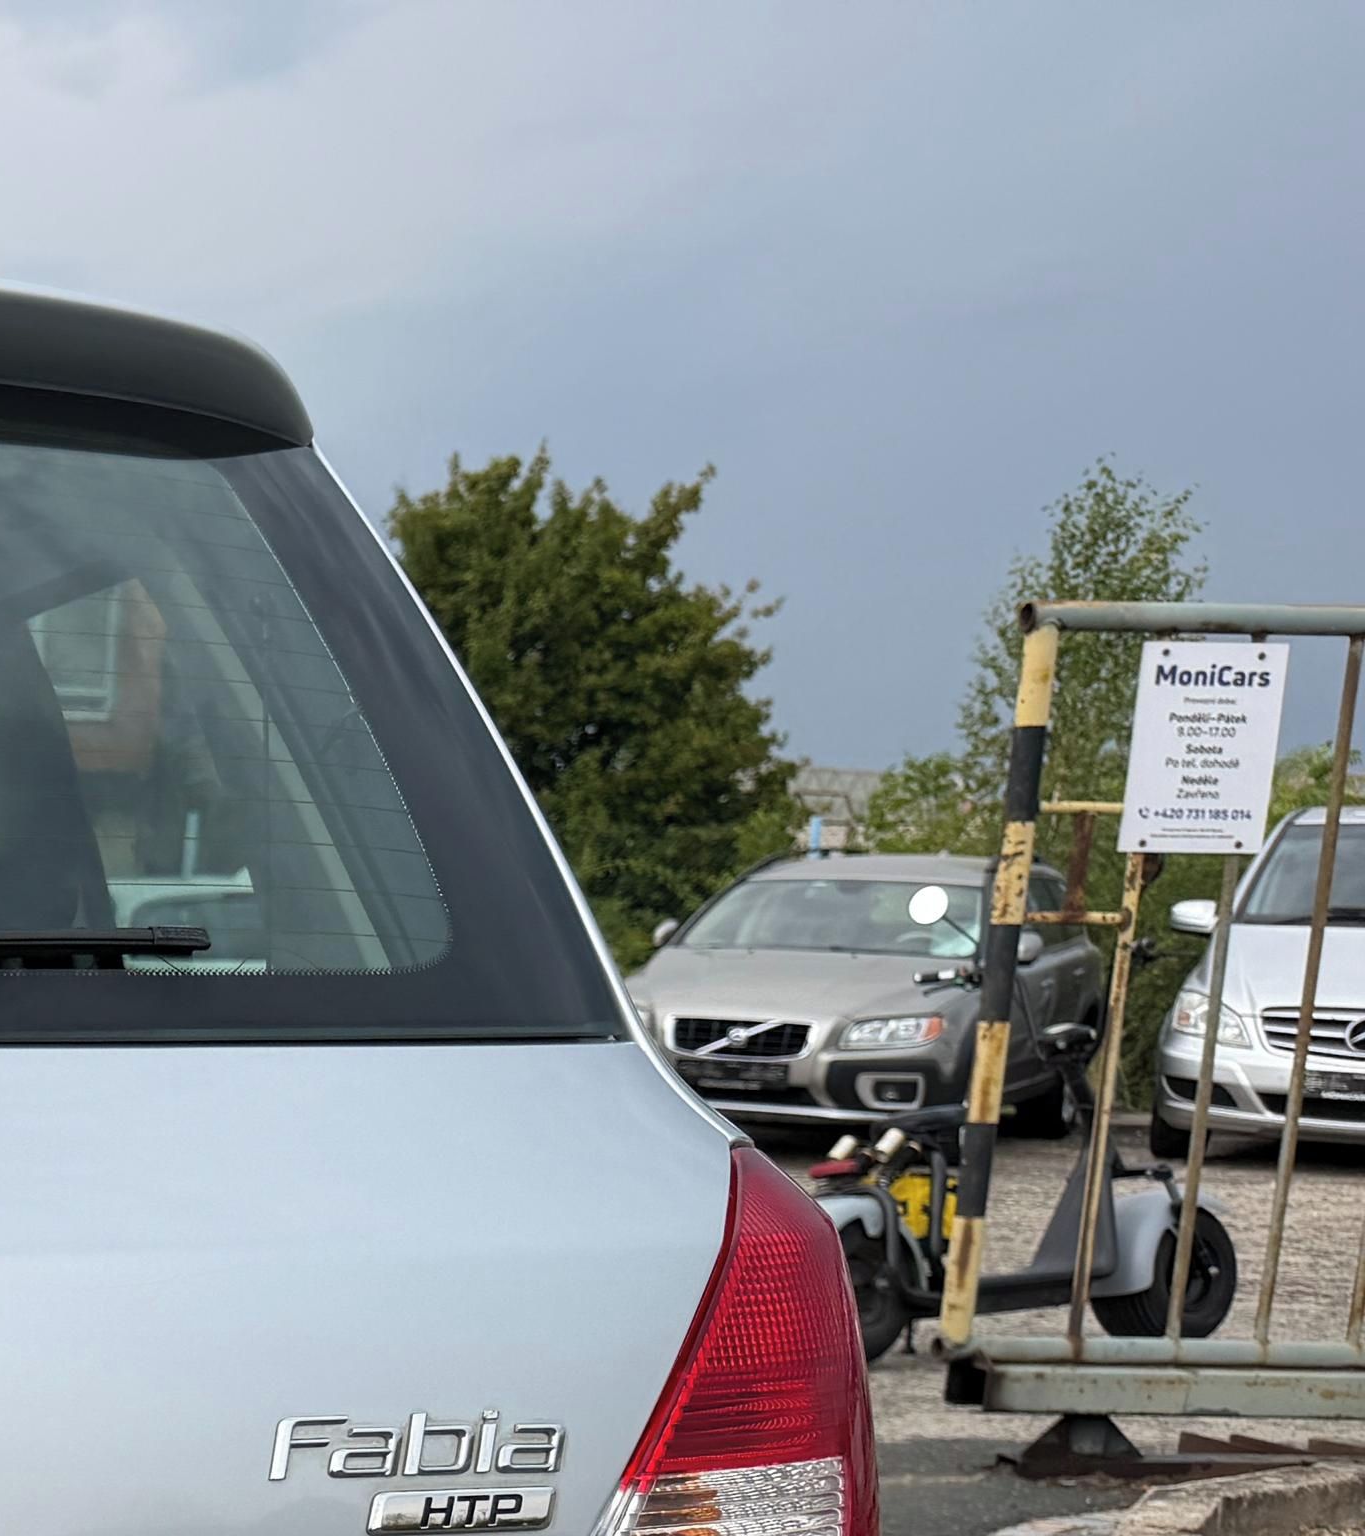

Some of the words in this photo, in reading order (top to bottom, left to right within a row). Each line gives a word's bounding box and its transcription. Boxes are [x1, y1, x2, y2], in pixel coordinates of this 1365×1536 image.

[1155, 664, 1271, 687] MoniCars
[1154, 808, 1184, 819] +420
[1186, 808, 1206, 819] 731
[1231, 809, 1252, 820] 014
[269, 1409, 567, 1482] Fabia
[420, 1494, 524, 1529] HTP
